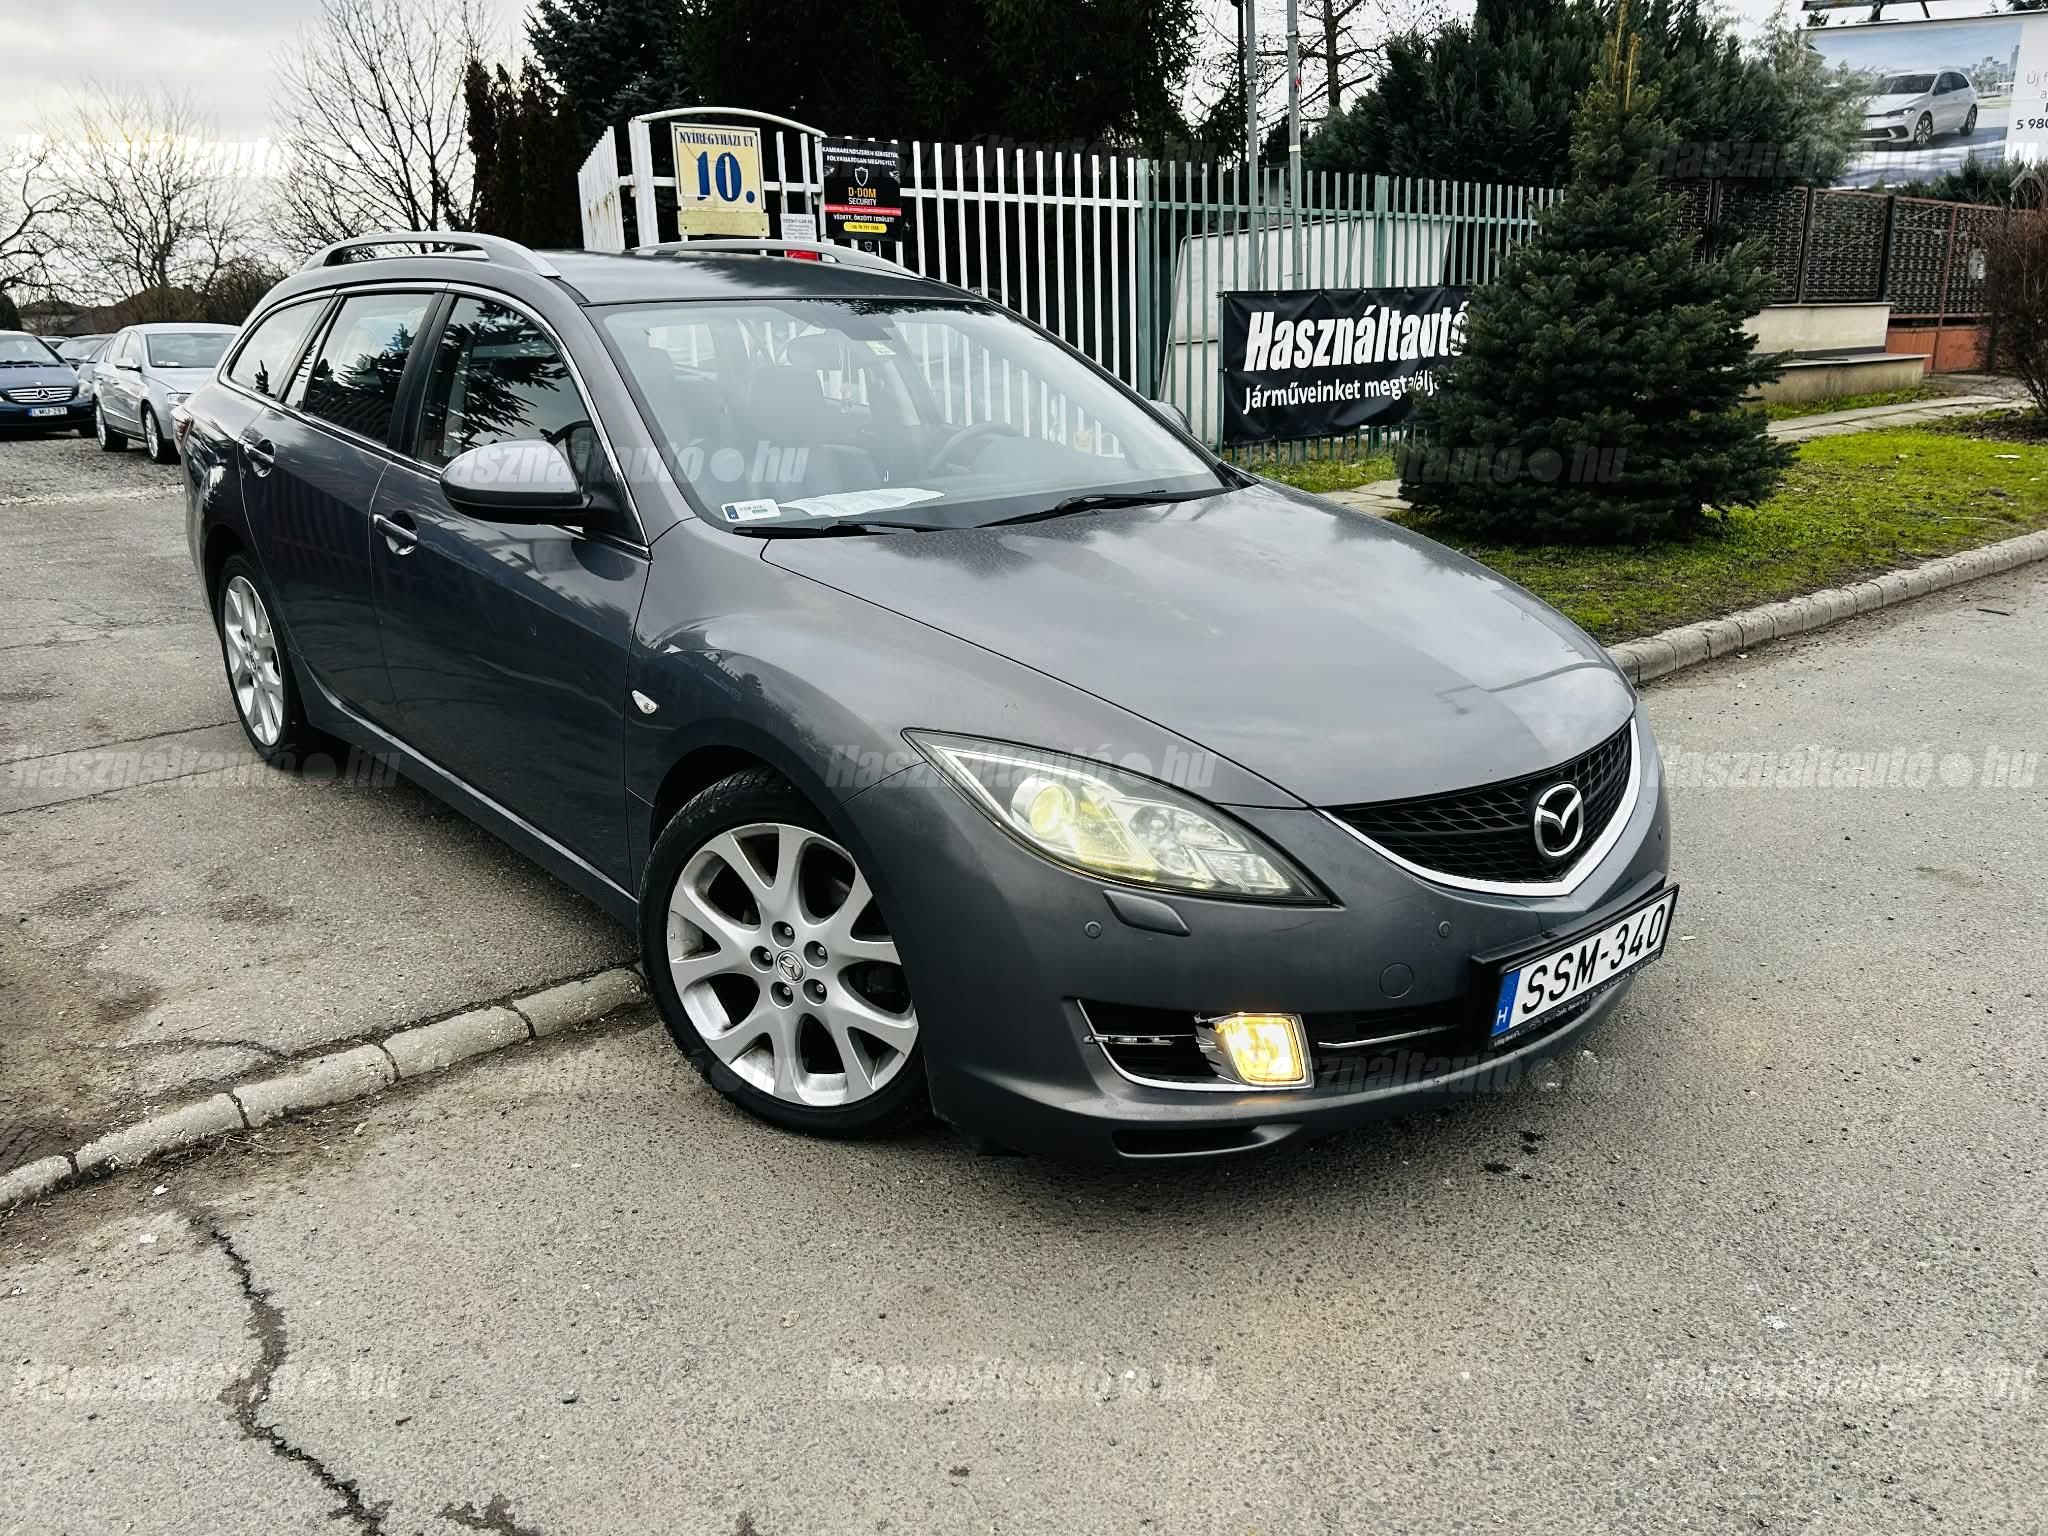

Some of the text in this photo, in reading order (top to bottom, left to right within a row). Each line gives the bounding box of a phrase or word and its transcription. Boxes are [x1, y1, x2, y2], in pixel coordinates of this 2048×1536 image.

[2016, 119, 2025, 130] 5
[696, 150, 756, 204] 10.
[848, 197, 877, 206] SECURITY
[1242, 378, 1361, 415] Járműveinket
[1521, 902, 1667, 1016] SSM-340
[1495, 1006, 1508, 1027] H
